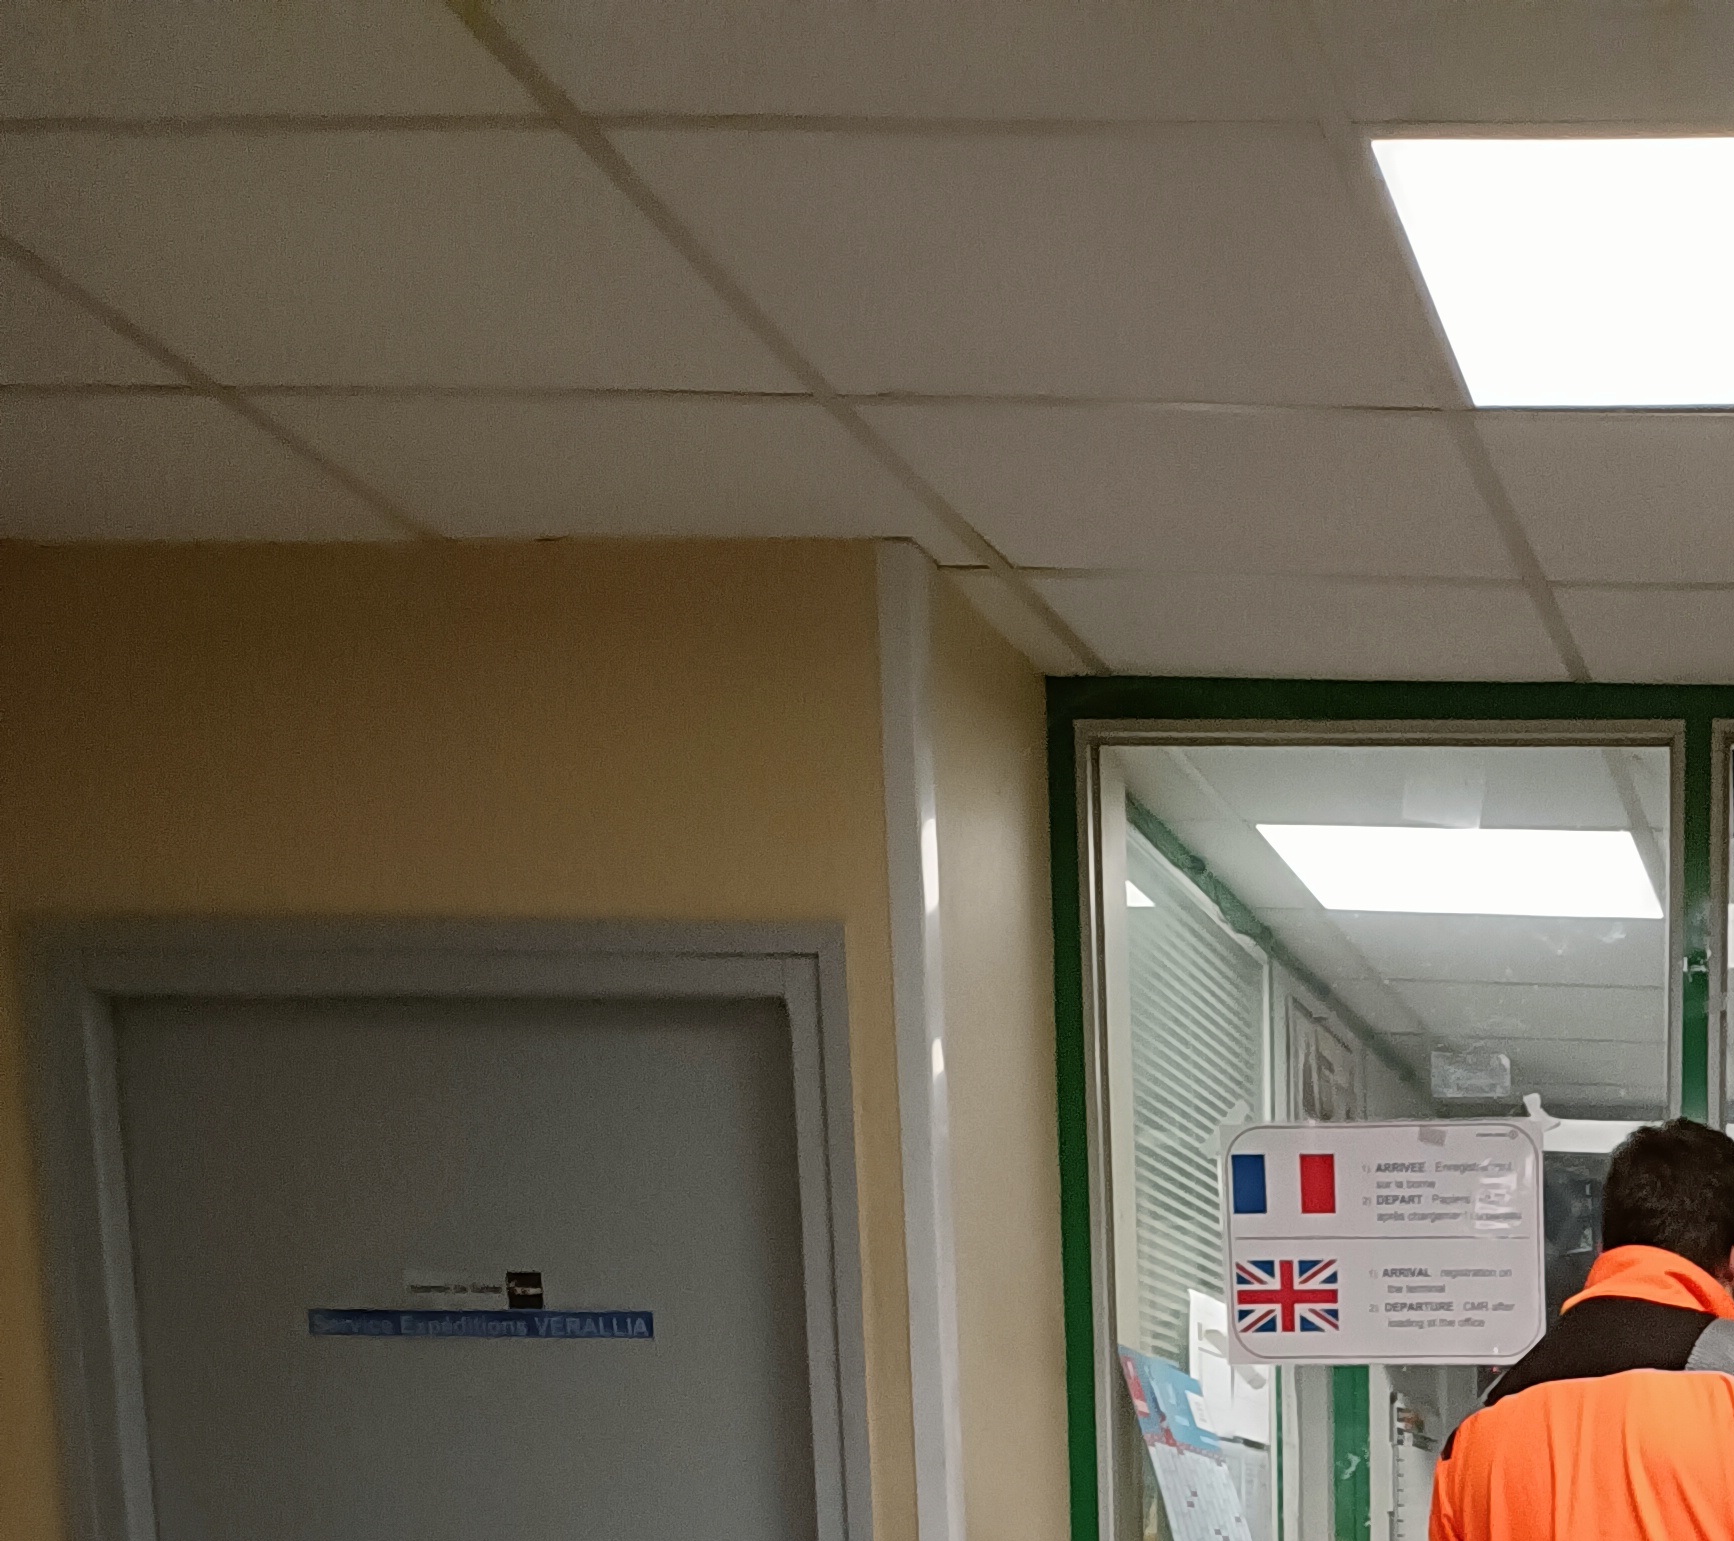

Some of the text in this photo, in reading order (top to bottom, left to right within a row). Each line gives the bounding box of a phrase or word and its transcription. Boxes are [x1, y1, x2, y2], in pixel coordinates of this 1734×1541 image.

[1381, 1267, 1432, 1278] ARRIVAL
[1384, 1301, 1454, 1312] DEPARTURE
[534, 1316, 650, 1337] VERALLIA
